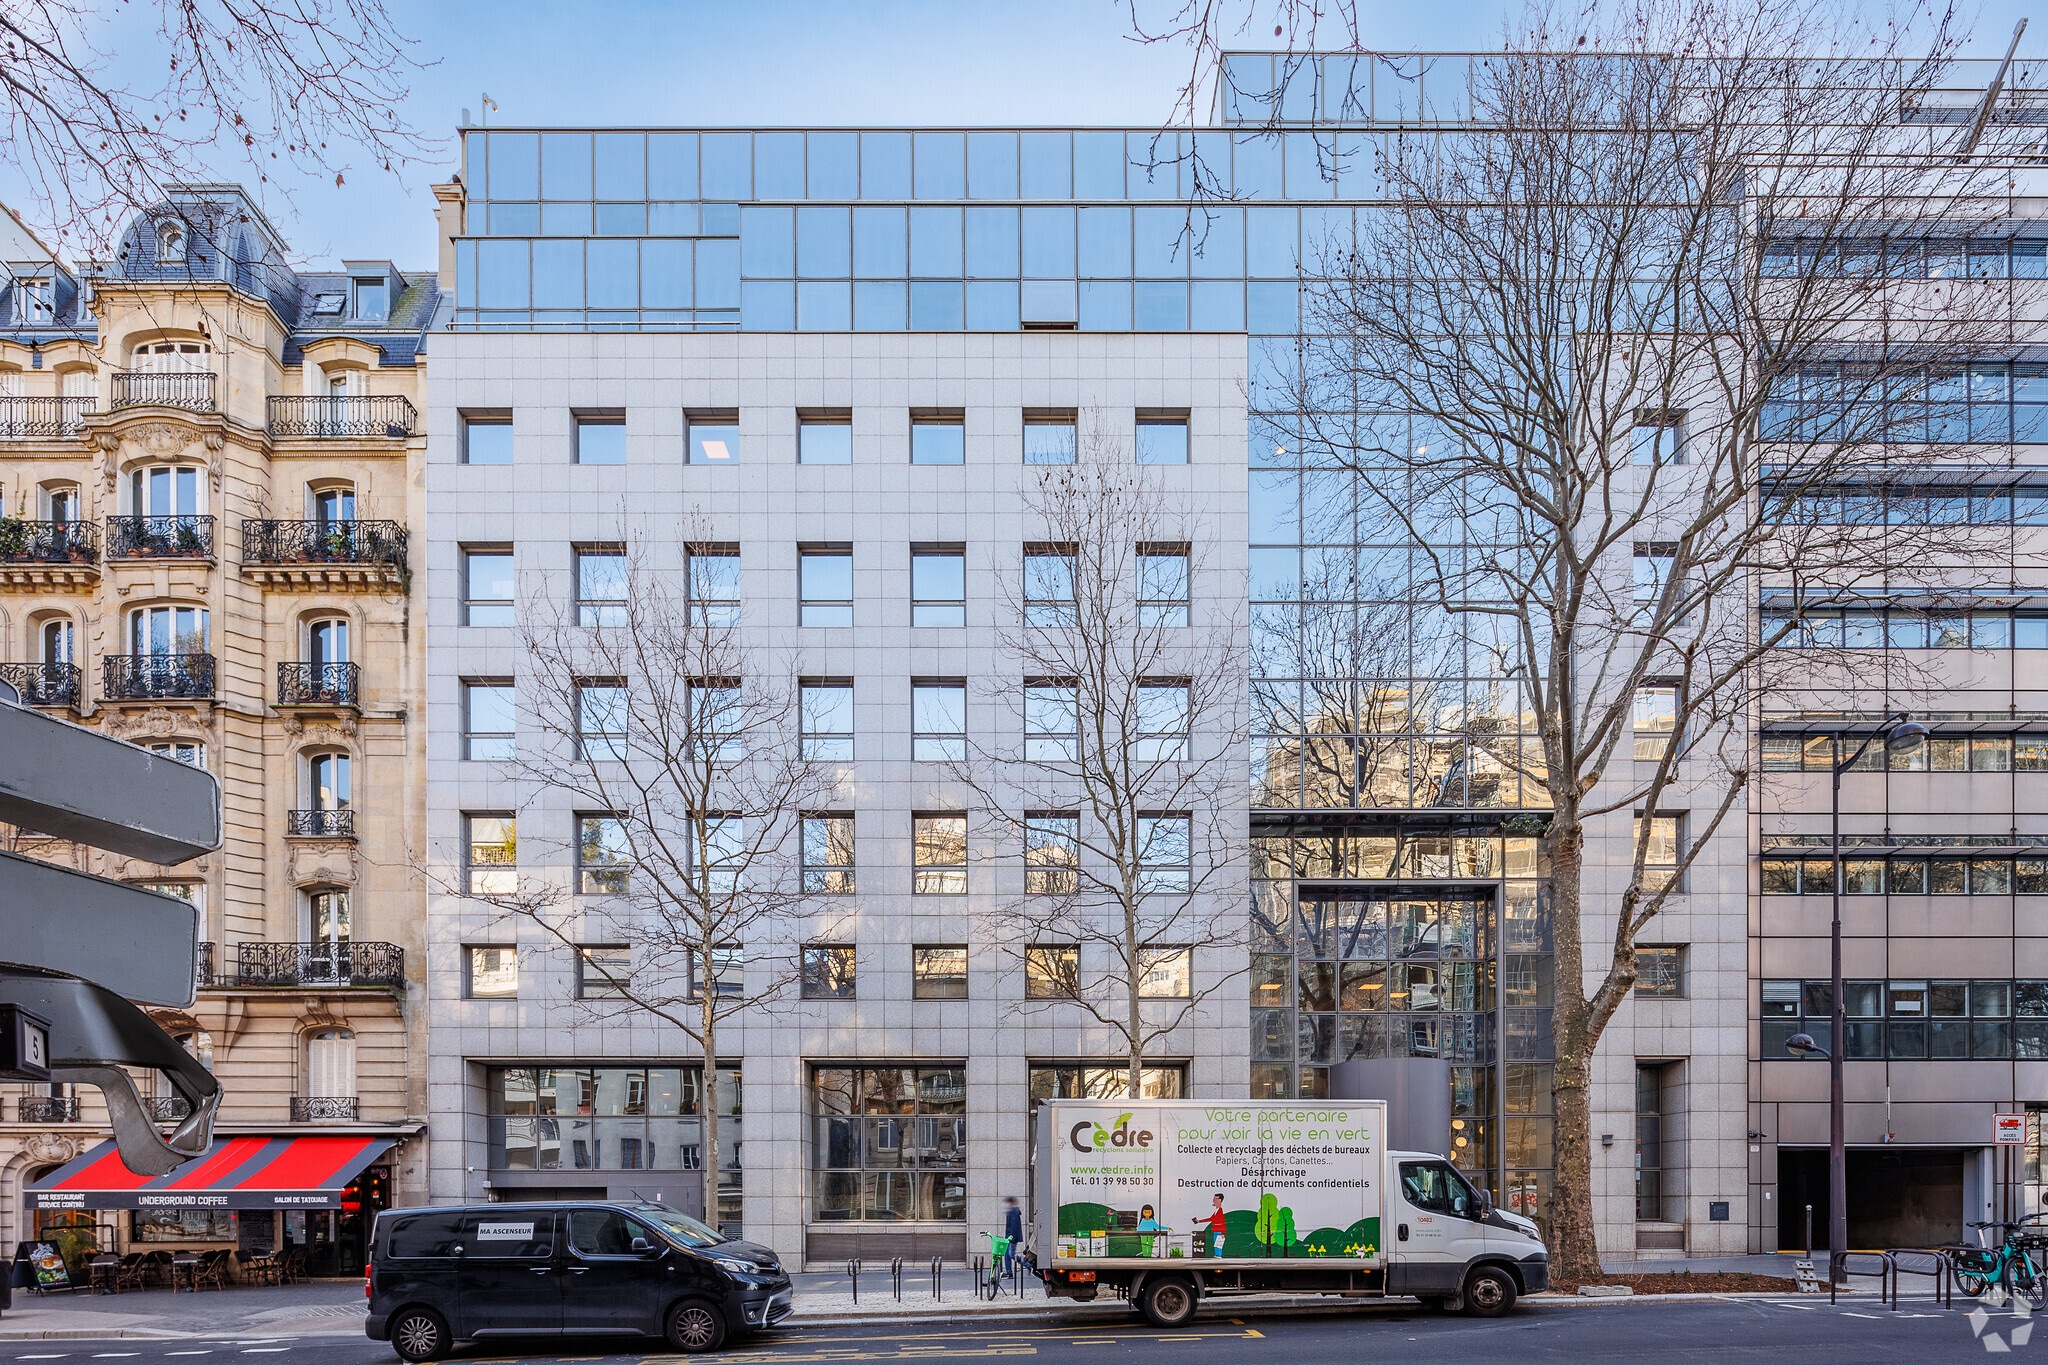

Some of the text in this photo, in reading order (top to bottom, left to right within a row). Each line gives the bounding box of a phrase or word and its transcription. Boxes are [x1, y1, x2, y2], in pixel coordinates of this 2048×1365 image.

[33, 1035, 39, 1060] 5
[1204, 1108, 1348, 1125] Votre partenaire
[1070, 1120, 1154, 1153] Cèdre
[1177, 1126, 1371, 1143] pour voir la vie en vert
[1177, 1144, 1370, 1156] Collecte et recyclage des déchets de bureaux
[1215, 1155, 1334, 1167] Papiers, Cartons, Canettes...
[1069, 1165, 1154, 1175] www.cedre.info
[1241, 1167, 1307, 1179] Désarchivage
[1070, 1176, 1154, 1186] Tél. 01 39 98 50 30
[1177, 1178, 1370, 1188] Destruction de documents confidentiels
[37, 1193, 85, 1201] BAR RESTAURANT
[138, 1196, 229, 1206] UNDERGROUND COFFEE
[274, 1196, 293, 1204] SALON
[292, 1196, 301, 1204] DE
[38, 1200, 85, 1209] SERVICE CONTINU
